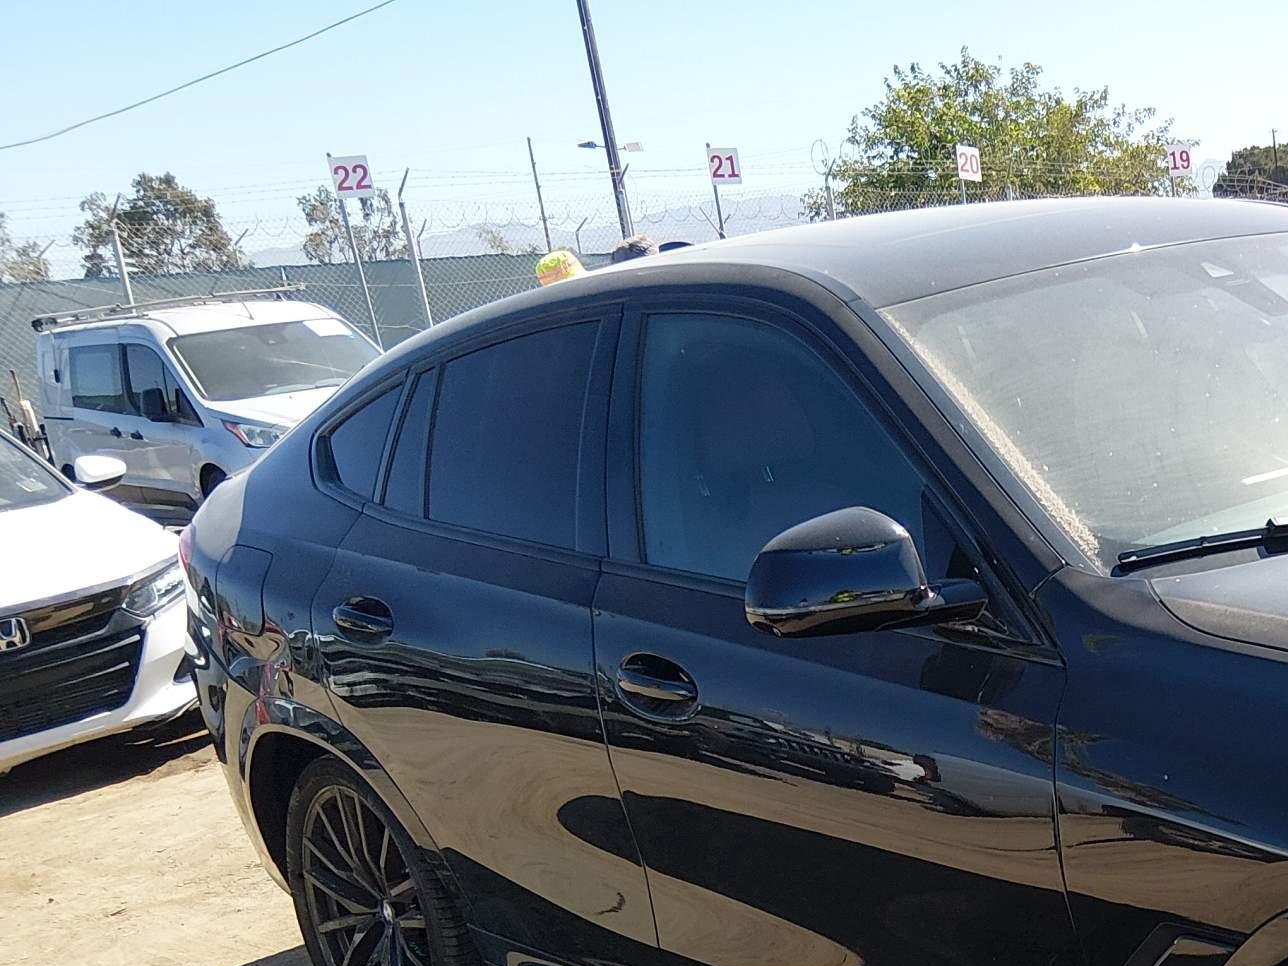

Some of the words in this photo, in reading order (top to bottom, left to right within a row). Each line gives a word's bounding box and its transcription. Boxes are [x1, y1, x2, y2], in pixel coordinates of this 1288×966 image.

[709, 154, 741, 178] 21
[958, 152, 980, 175] 20
[1168, 150, 1191, 170] 19
[333, 163, 372, 191] 22
